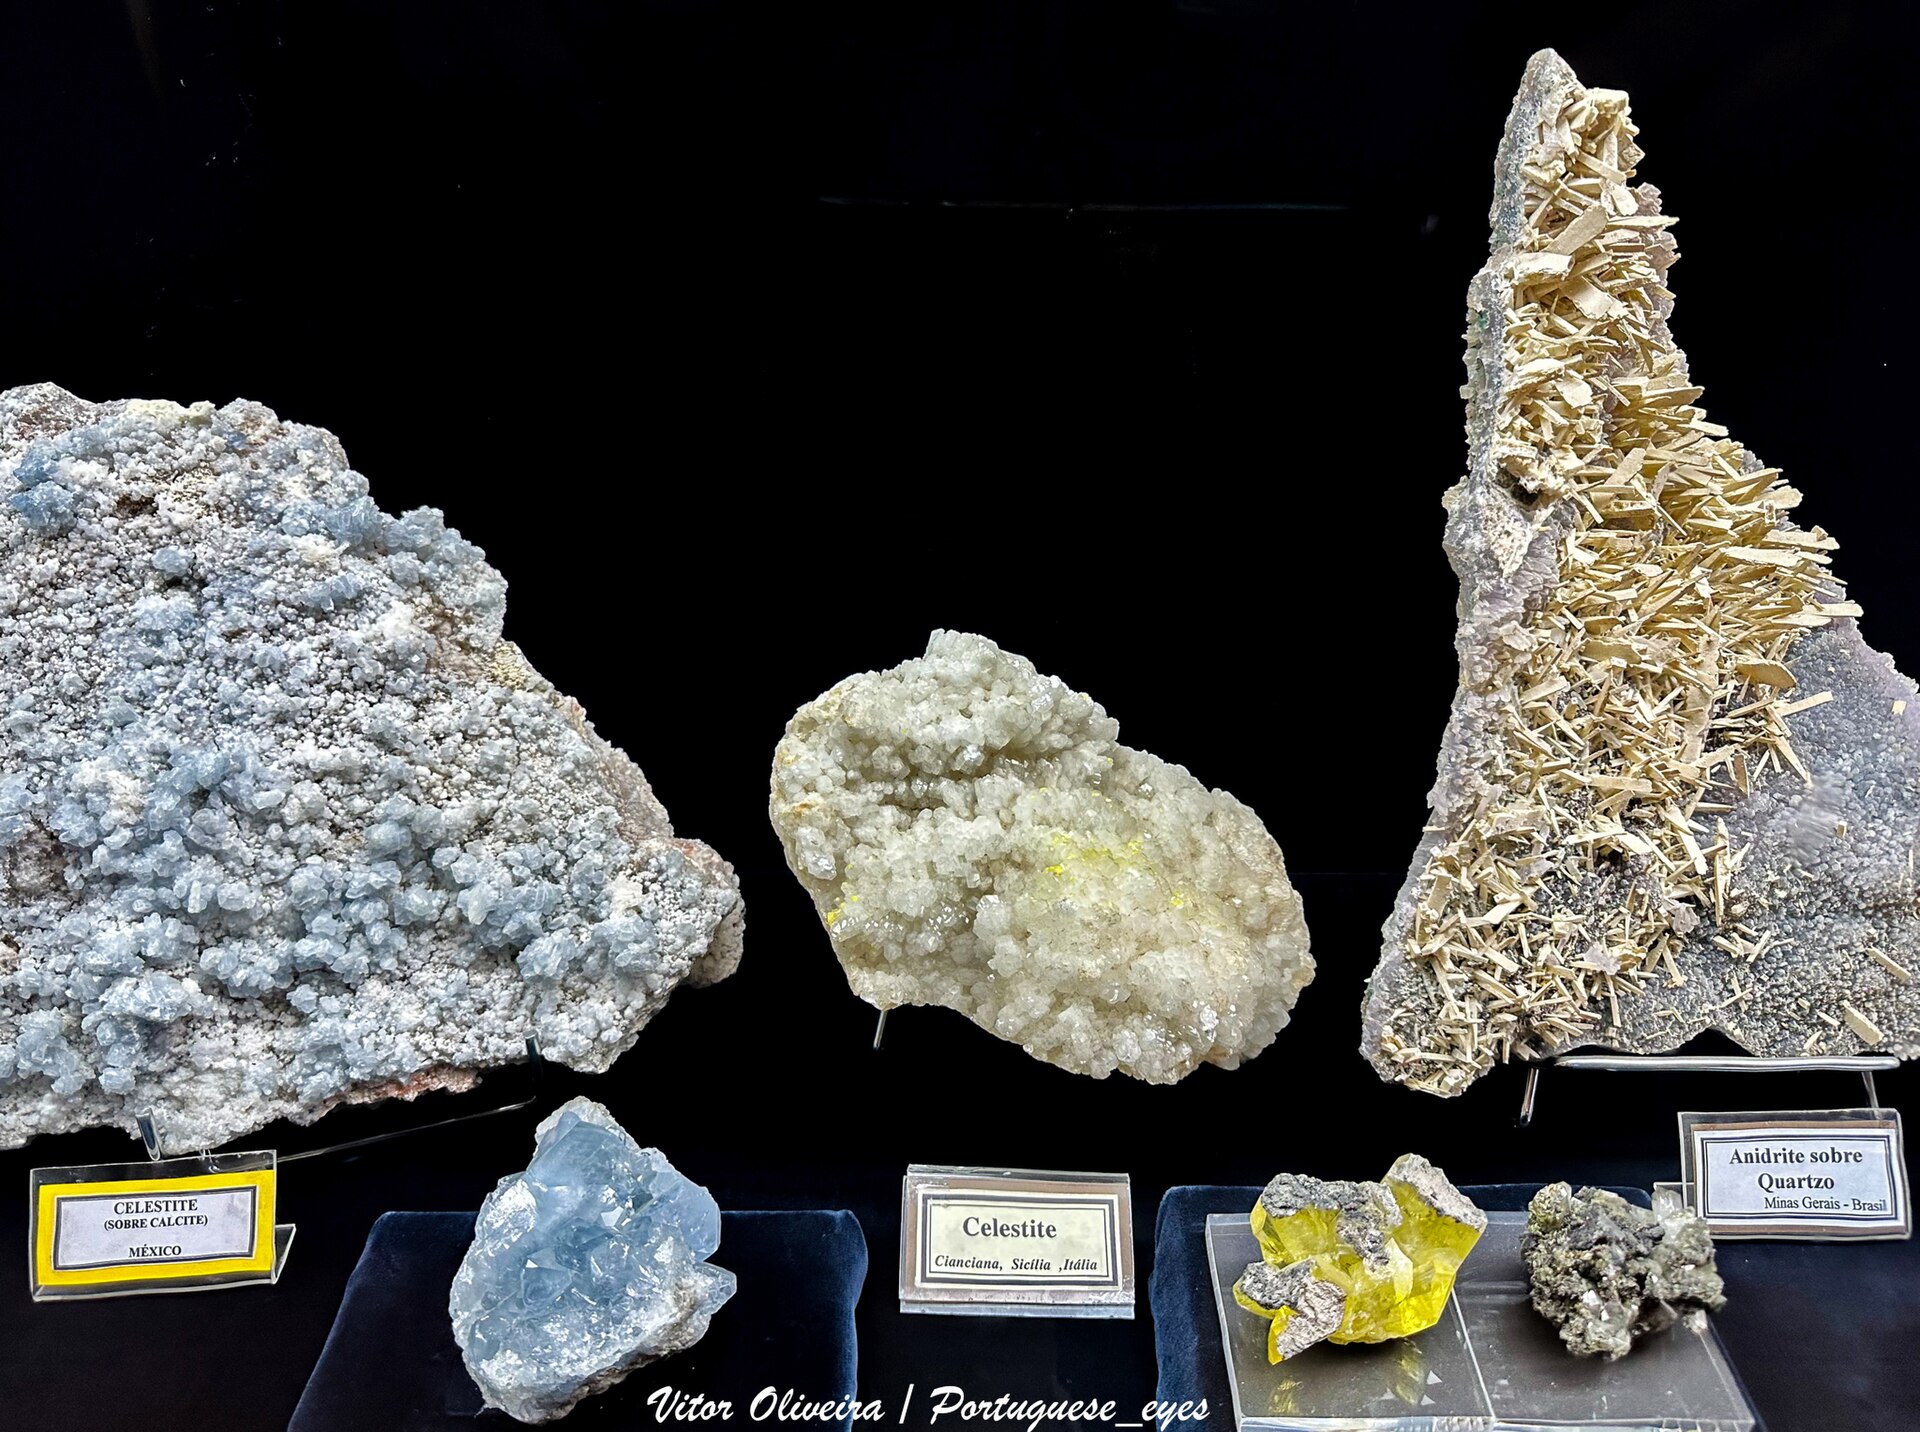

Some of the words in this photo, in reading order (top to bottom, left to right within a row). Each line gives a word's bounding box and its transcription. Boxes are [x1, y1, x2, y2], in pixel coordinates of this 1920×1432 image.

[1729, 1147, 1805, 1165] Anidrite
[1809, 1147, 1863, 1164] sobre
[1757, 1173, 1835, 1193] Quartzo
[113, 1199, 198, 1215] CELESTITE
[1764, 1196, 1799, 1209] Minas
[1801, 1196, 1841, 1210] Gerais
[1852, 1198, 1888, 1212] Brasil
[104, 1218, 148, 1231] (SOBRE
[150, 1215, 208, 1228] CALCITE)
[962, 1216, 1057, 1238] Celestite
[128, 1243, 182, 1257] MÉXICO
[934, 1254, 1003, 1272] Cianciana,
